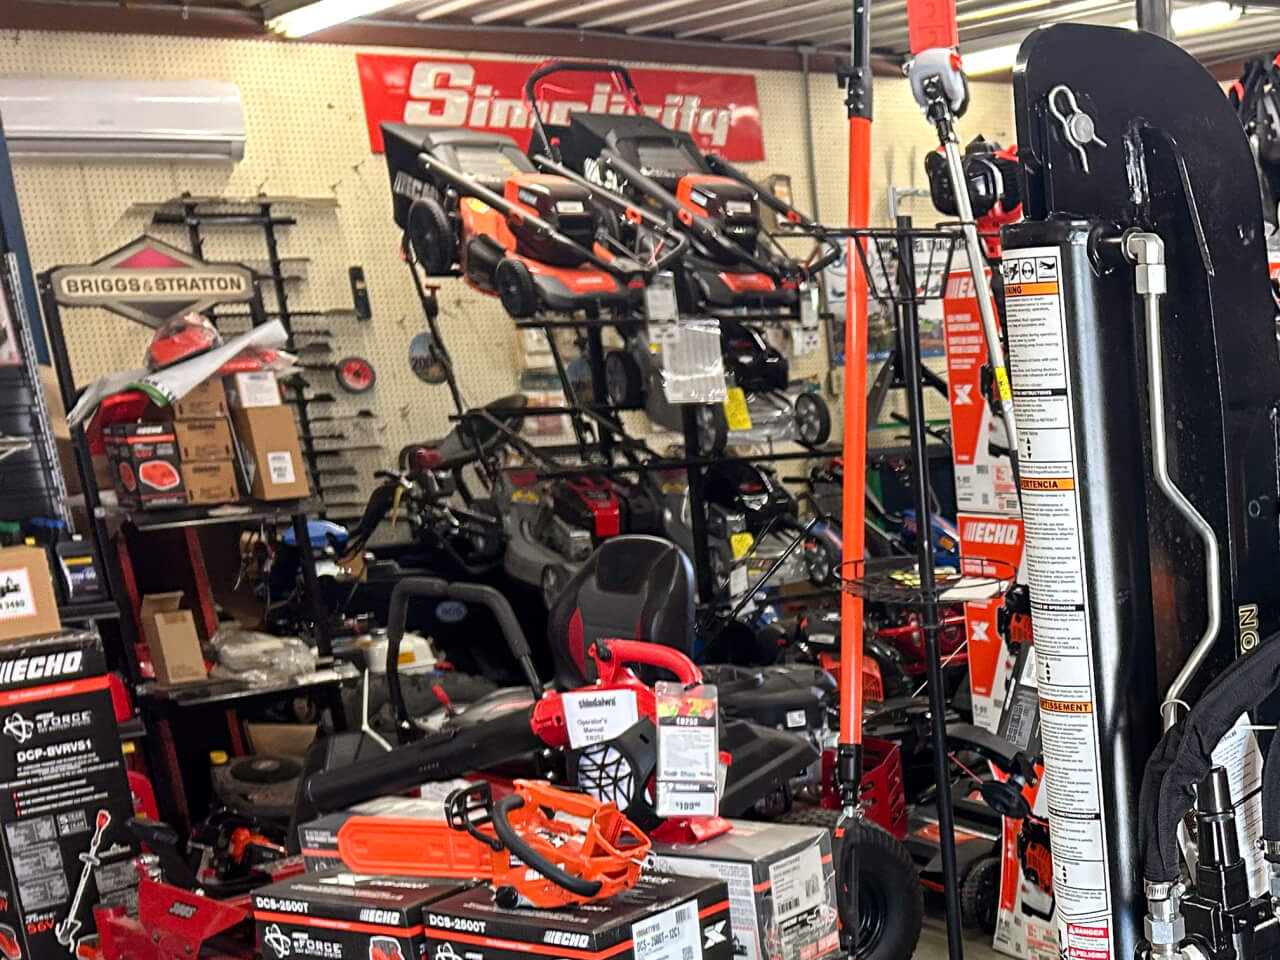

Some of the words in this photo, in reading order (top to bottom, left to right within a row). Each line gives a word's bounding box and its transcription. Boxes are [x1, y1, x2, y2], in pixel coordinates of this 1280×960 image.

[974, 522, 1018, 545] ECHO
[12, 651, 83, 681] ECHO
[369, 910, 400, 925] ECHO
[553, 931, 590, 948] ECHO
